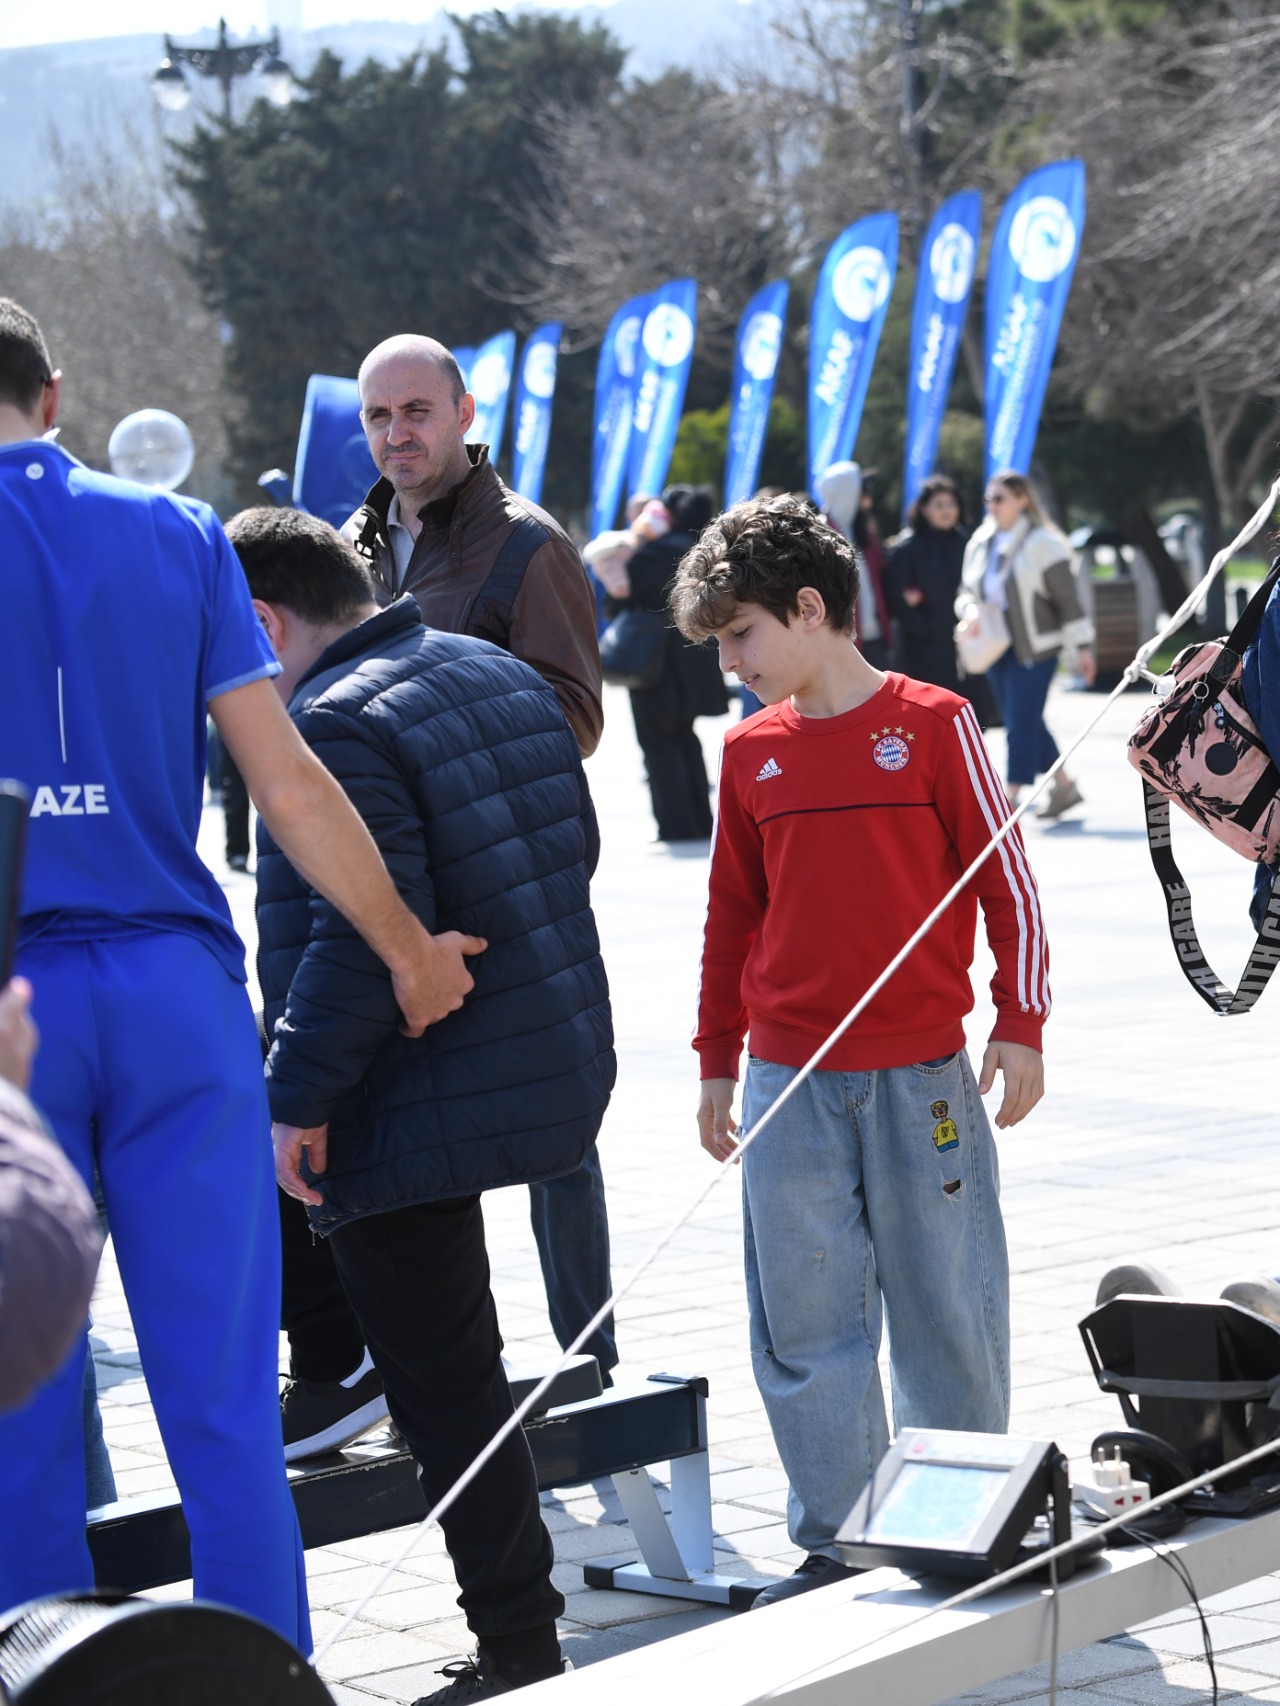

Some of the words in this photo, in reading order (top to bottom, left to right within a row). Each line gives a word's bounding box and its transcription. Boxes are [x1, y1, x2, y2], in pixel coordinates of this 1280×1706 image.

[756, 768, 782, 781] adidas
[30, 784, 109, 817] AZE
[1147, 784, 1171, 848] HAN
[1166, 882, 1203, 963] CARE
